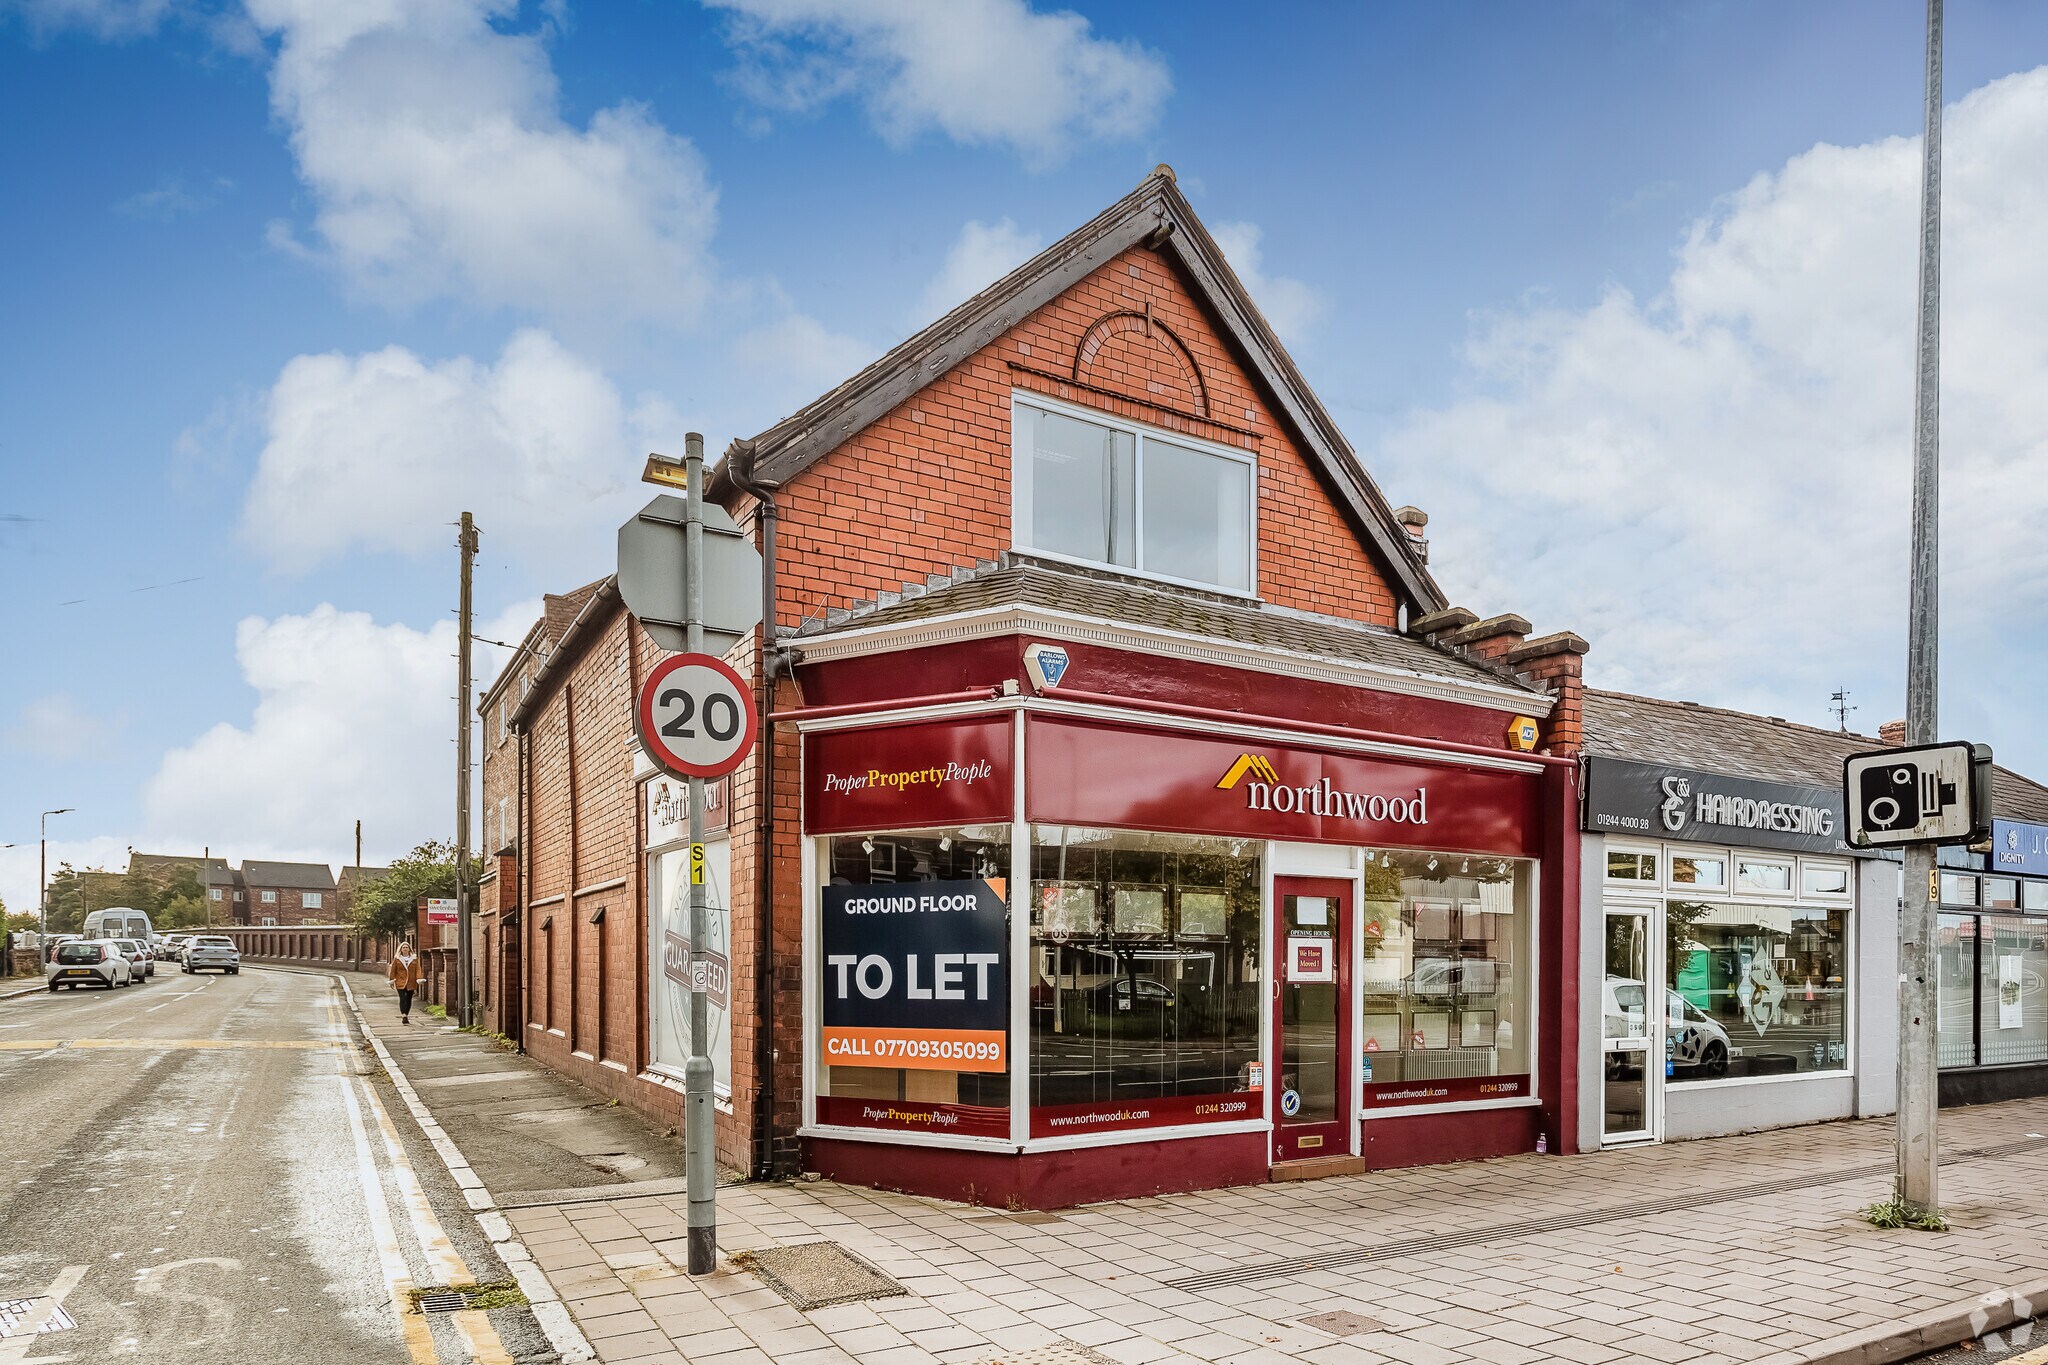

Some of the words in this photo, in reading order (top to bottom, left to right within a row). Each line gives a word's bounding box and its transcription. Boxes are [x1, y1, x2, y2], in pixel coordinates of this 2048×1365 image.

[1040, 652, 1066, 660] BARLOWS
[1041, 658, 1064, 666] ALARMS
[659, 688, 740, 742] 20
[1247, 777, 1429, 825] northwood
[1597, 813, 1619, 826] 01244
[1620, 815, 1639, 828] 4000
[1640, 818, 1650, 830] 28
[1696, 791, 1834, 837] HAIRDRESSING
[2000, 851, 2025, 864] DIGNITY
[844, 898, 917, 914] GROUND
[919, 894, 978, 913] FLOOR
[1299, 949, 1307, 957] We
[664, 940, 726, 995] GUAREED
[828, 953, 894, 1000] TO
[906, 953, 999, 1000] LET
[827, 1038, 871, 1056] CALL
[873, 1039, 1001, 1061] 07709305099
[1376, 1087, 1448, 1101] www.northwooduk.com
[1480, 1083, 1498, 1094] 01244
[1498, 1082, 1518, 1093] 320999
[1050, 1109, 1150, 1127] www.northwooduk.com
[1195, 1103, 1219, 1115] 01244
[1219, 1101, 1247, 1113] 320999
